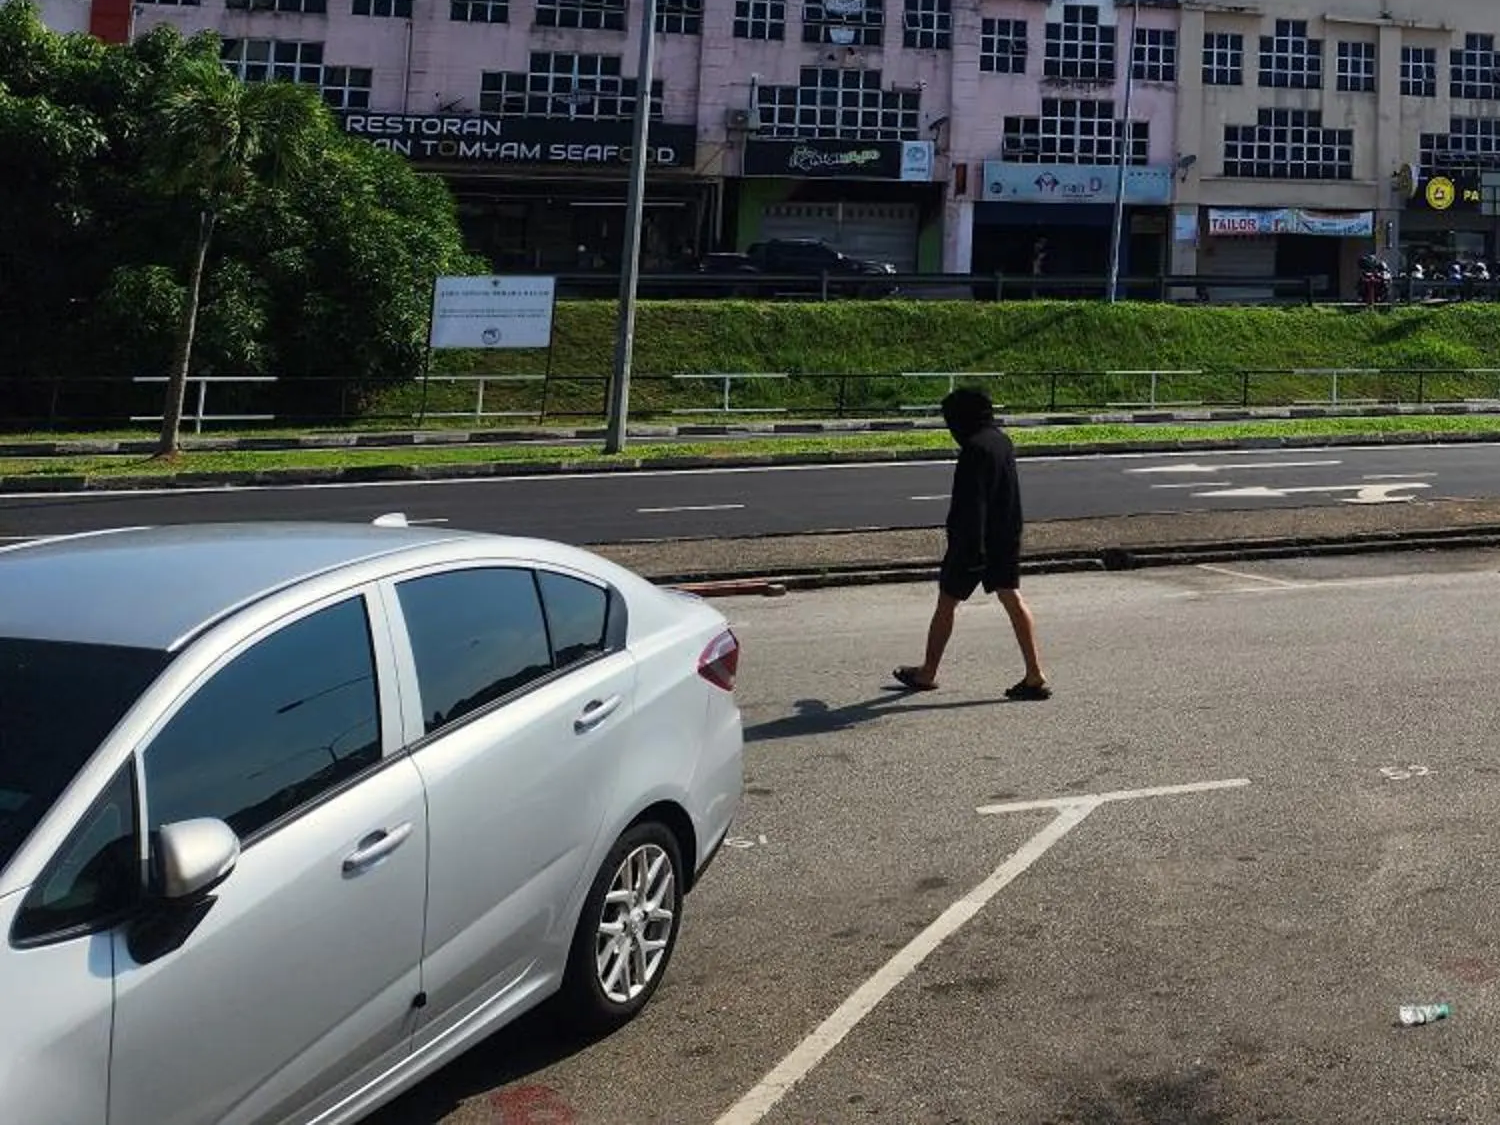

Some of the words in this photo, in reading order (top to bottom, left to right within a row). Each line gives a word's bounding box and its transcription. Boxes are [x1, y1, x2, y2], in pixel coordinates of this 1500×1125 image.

[346, 115, 502, 136] RESTORAN
[419, 139, 541, 159] TOMYAM
[1212, 218, 1257, 232] TAILOR
